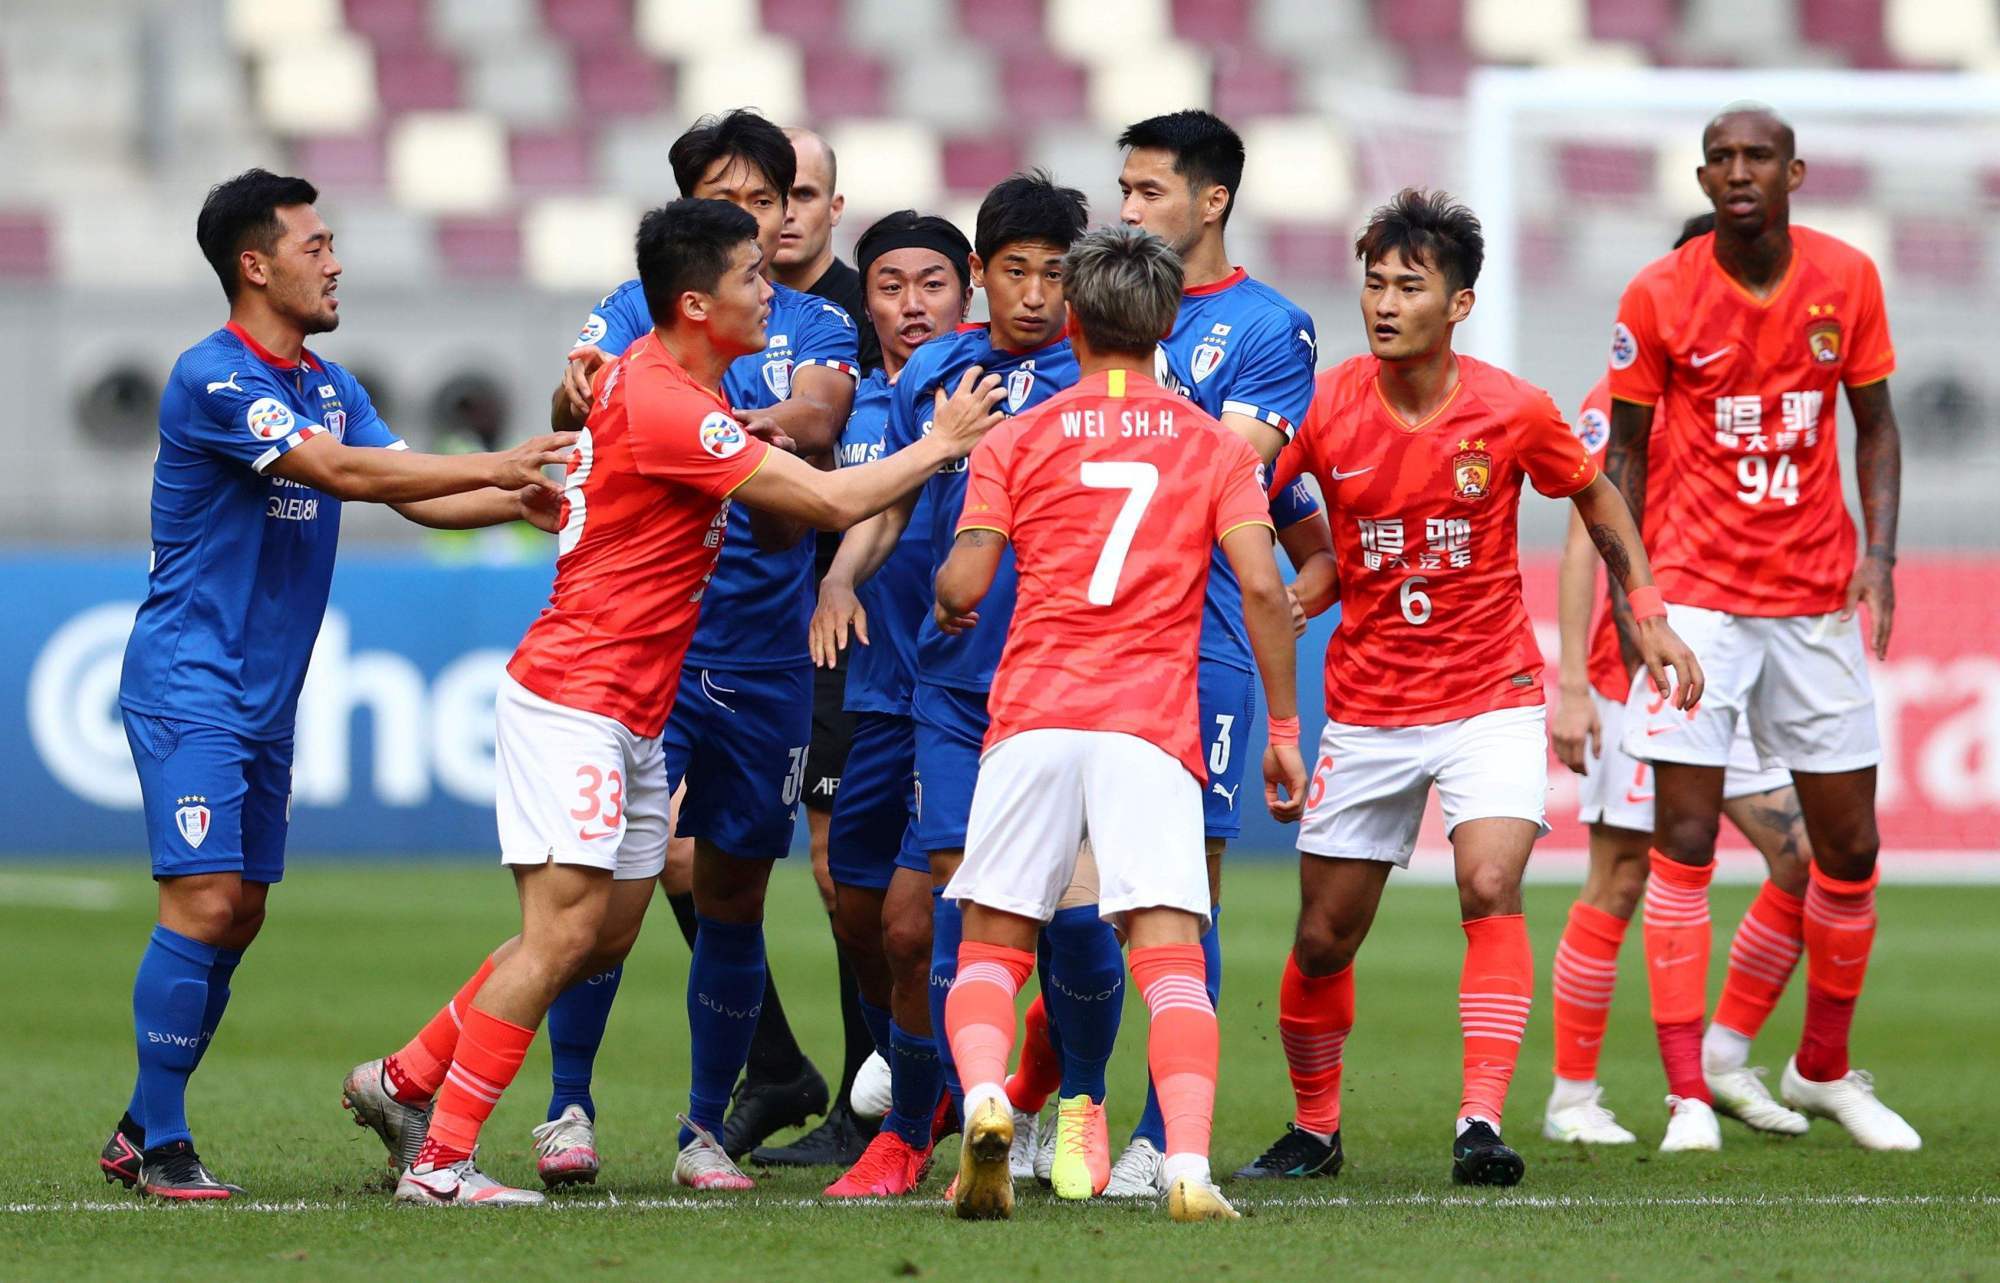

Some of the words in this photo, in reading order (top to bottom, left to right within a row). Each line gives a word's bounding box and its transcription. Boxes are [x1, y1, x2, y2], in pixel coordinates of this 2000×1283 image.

[1060, 409, 1105, 438] WEI
[1120, 409, 1180, 439] SH.H.
[1735, 454, 1800, 506] 94
[1079, 461, 1160, 607] 7
[1357, 517, 1472, 555] 恒驰
[1363, 549, 1472, 571] 恒大汽车
[1400, 575, 1433, 626] 6
[1209, 713, 1235, 775] 3
[569, 764, 623, 829] 33
[1307, 755, 1335, 810] 6
[698, 992, 763, 1020] SUWO
